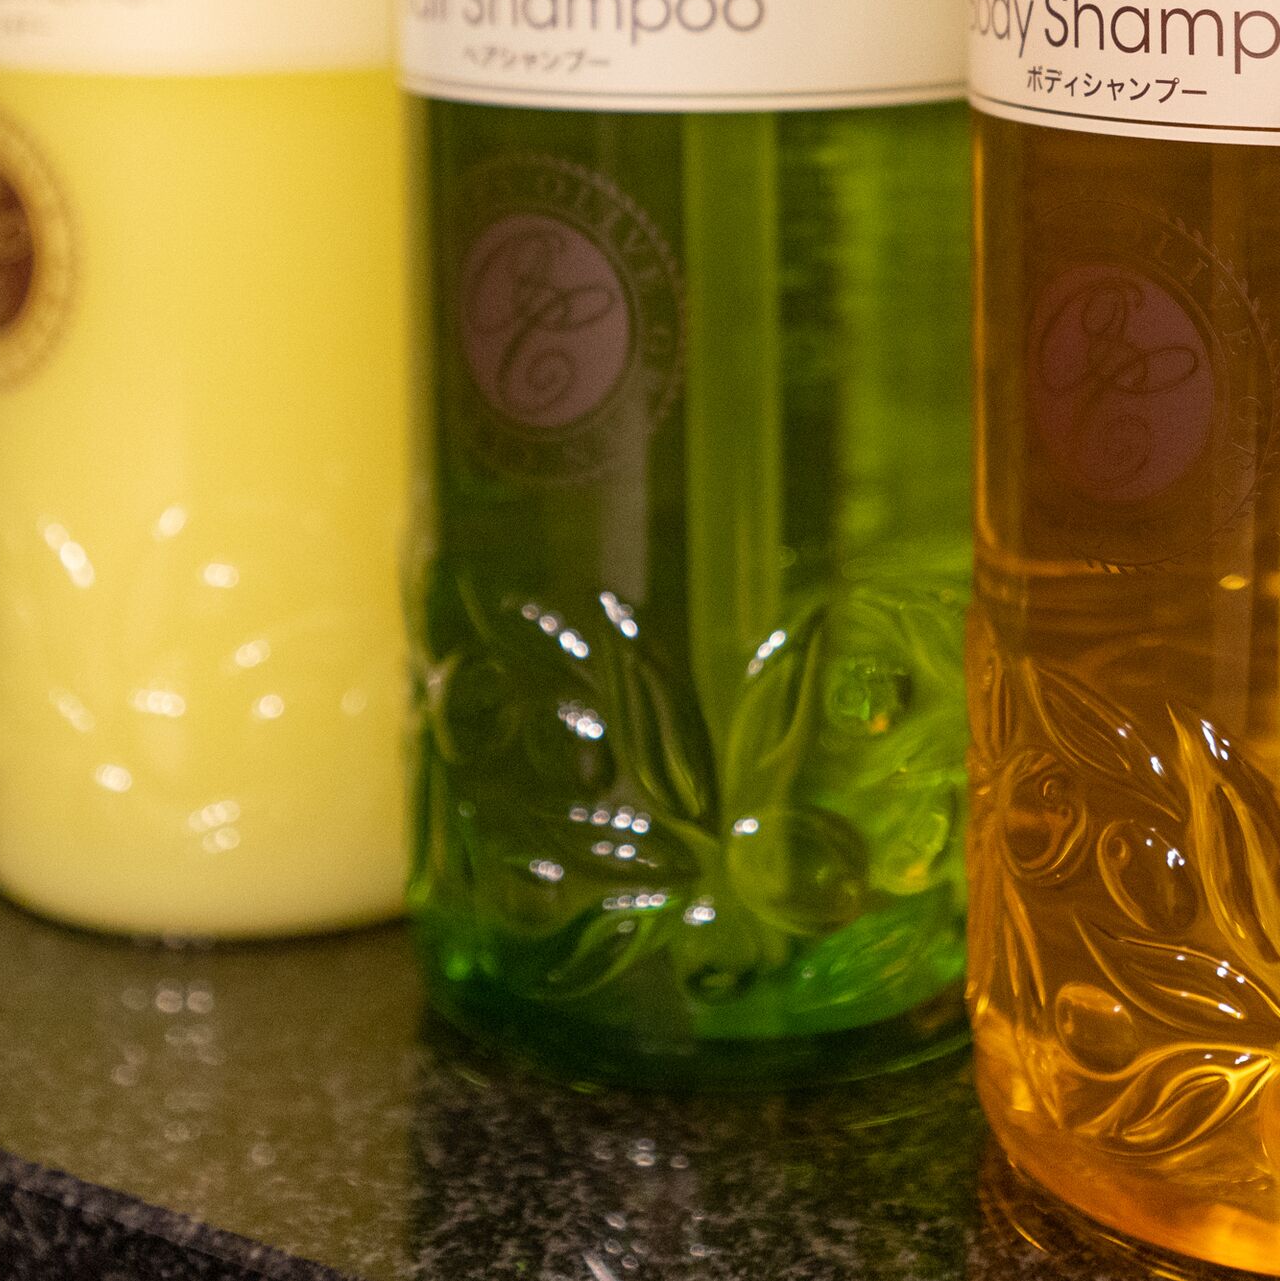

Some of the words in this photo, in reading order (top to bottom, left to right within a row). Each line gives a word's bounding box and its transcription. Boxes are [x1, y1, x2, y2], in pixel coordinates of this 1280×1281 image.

[463, 45, 611, 72] ヘアシャンプー
[1026, 66, 1208, 104] ボディシャンプー
